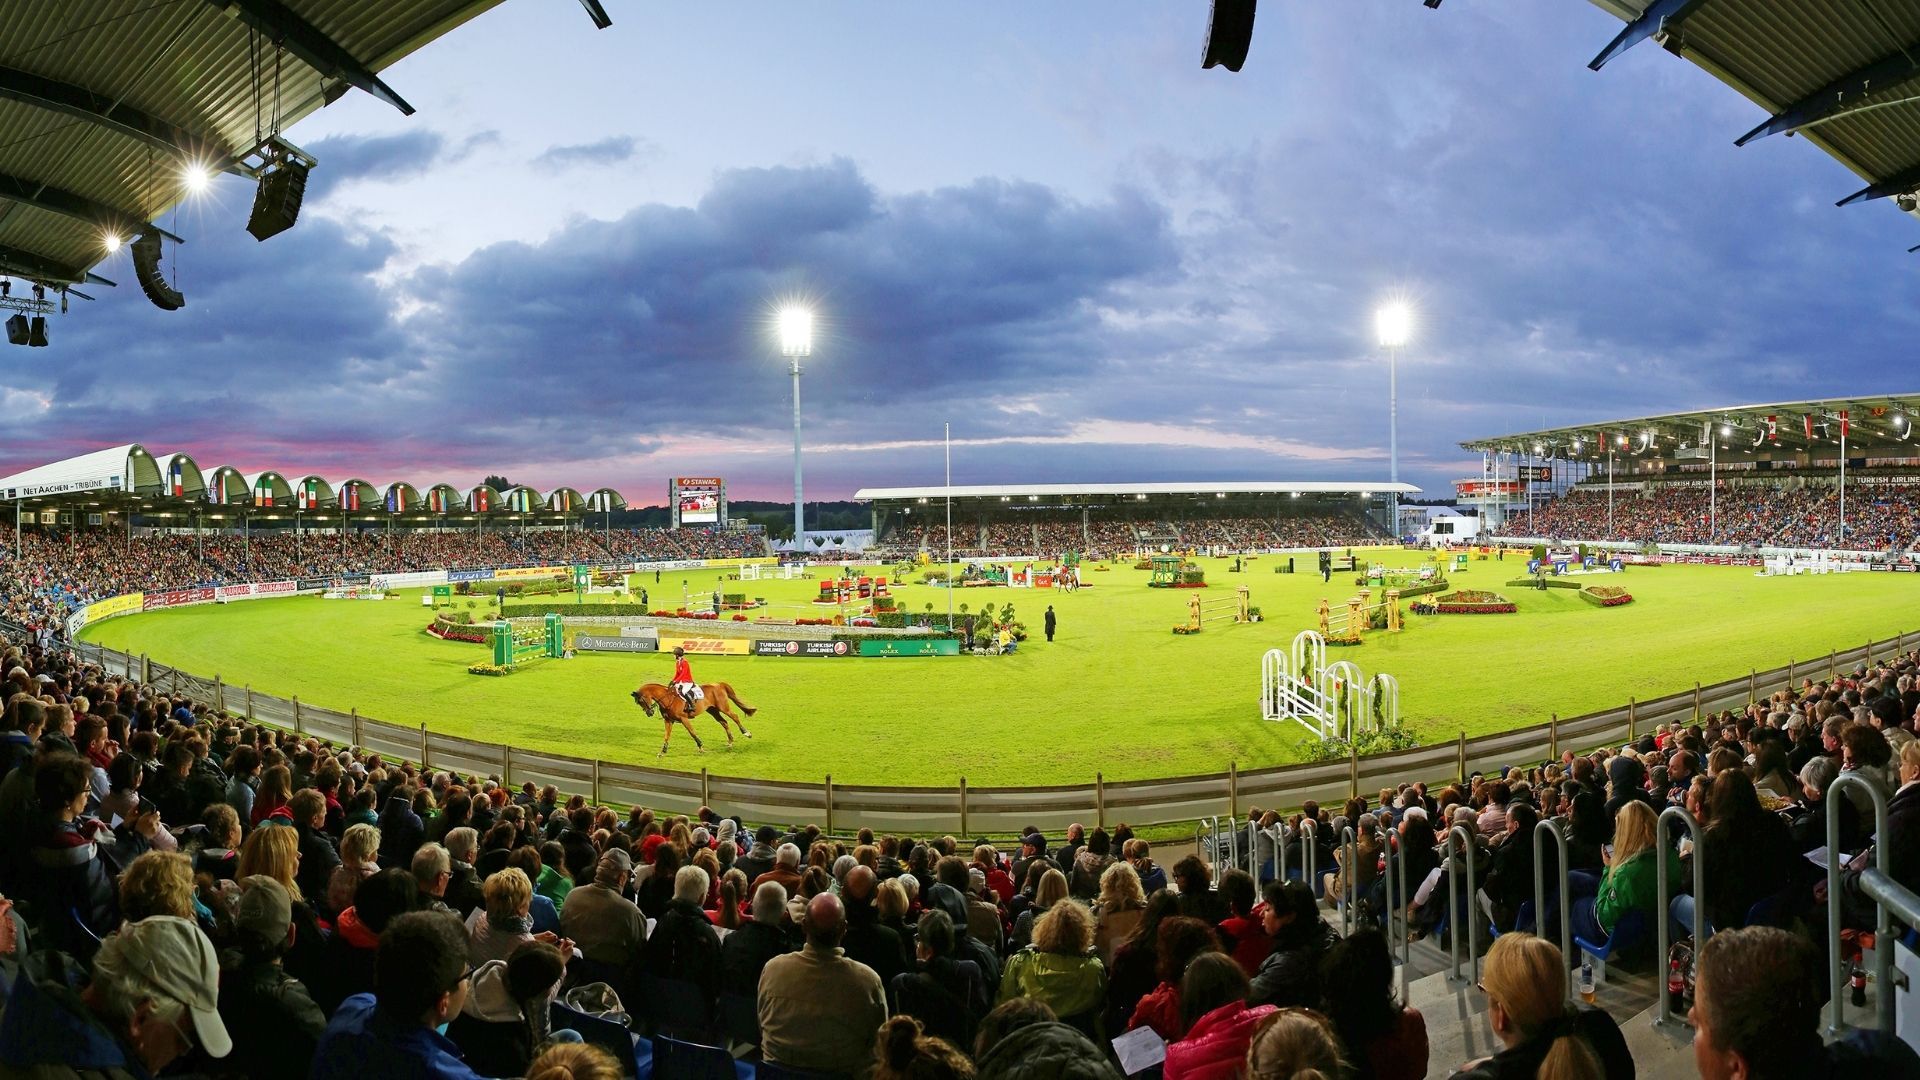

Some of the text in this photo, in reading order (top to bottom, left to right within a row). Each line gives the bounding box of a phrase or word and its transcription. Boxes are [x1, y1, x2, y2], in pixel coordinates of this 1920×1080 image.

[75, 480, 102, 489] TRIBÜNE
[594, 639, 649, 649] Mercedes-Benz
[682, 640, 726, 651] DHL
